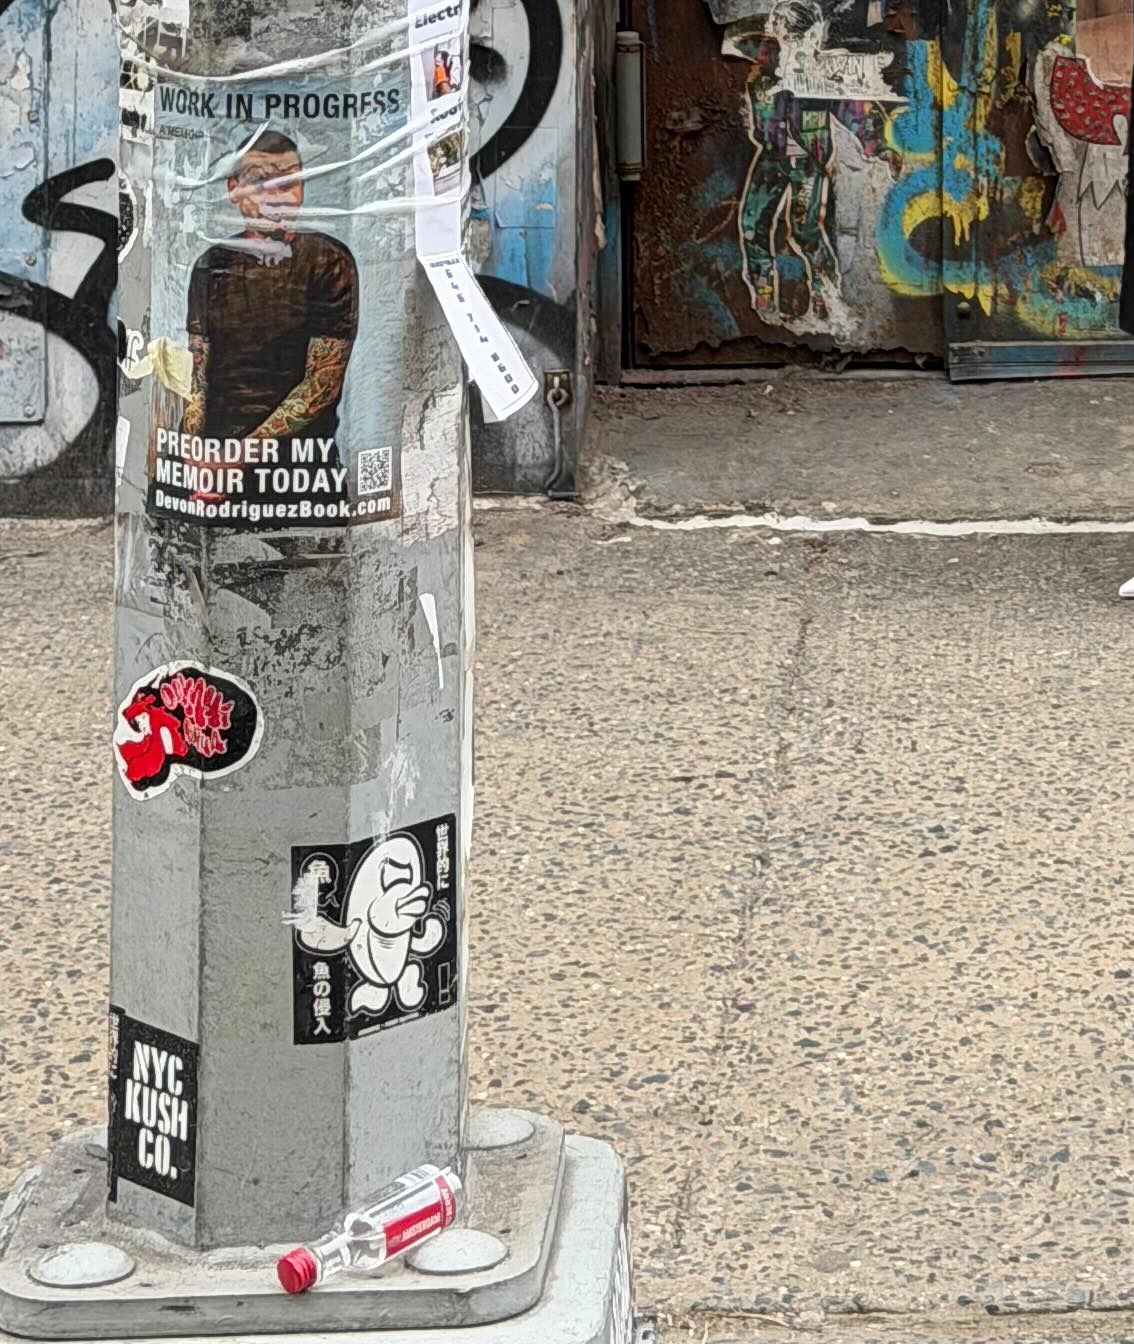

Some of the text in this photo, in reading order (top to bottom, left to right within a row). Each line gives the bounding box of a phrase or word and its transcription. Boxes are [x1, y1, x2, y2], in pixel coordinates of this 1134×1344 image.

[160, 85, 220, 118] WORK
[225, 92, 258, 120] IN
[264, 87, 401, 120] PROGRESS
[156, 428, 335, 464] PREORDER MY
[155, 461, 348, 496] MEMOIR TODAY
[155, 489, 392, 522] DevonRodriguezBook.com
[133, 1039, 184, 1097] NYC
[124, 1077, 189, 1142] KUSH
[138, 1127, 178, 1180] CO.
